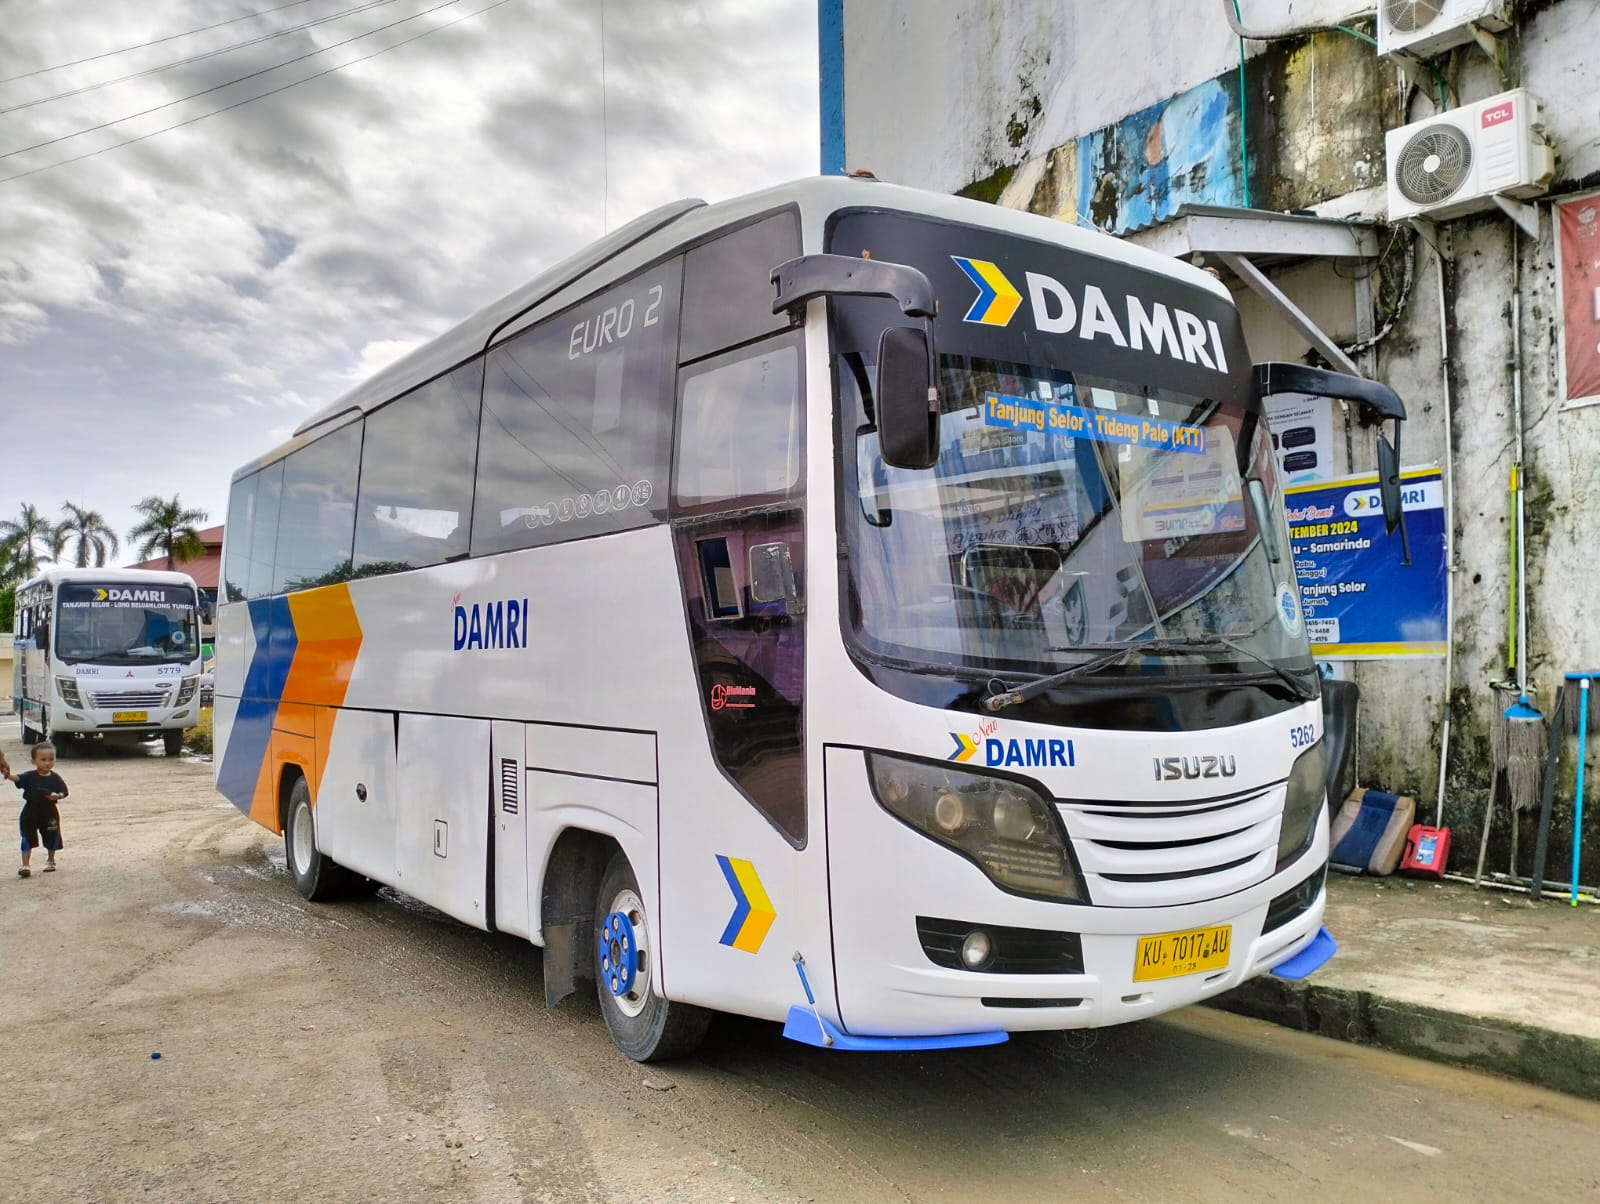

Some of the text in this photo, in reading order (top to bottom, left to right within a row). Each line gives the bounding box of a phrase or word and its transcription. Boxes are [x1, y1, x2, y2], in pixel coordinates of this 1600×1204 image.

[1485, 109, 1509, 122] TCL
[569, 285, 663, 361] EURO 2
[1025, 271, 1229, 374] DAMRI
[987, 397, 1045, 430] Tanjung
[1048, 407, 1085, 431] Selor
[1095, 415, 1139, 444] Tideng
[1142, 422, 1169, 442] Pale
[1171, 427, 1205, 450] (KTT)
[1369, 489, 1426, 509] DMRI
[1330, 521, 1359, 537] 2024
[1310, 538, 1371, 553] Samarinda
[109, 589, 165, 602] DAMRI
[1338, 581, 1367, 593] Selor
[453, 597, 529, 651] DAMRI
[157, 666, 182, 675] 5779
[972, 717, 998, 746] New
[1290, 723, 1315, 749] 5262
[985, 738, 1075, 767] DAMRI
[1152, 754, 1237, 782] ISUZU
[1142, 929, 1229, 967] KU 7017 AU
